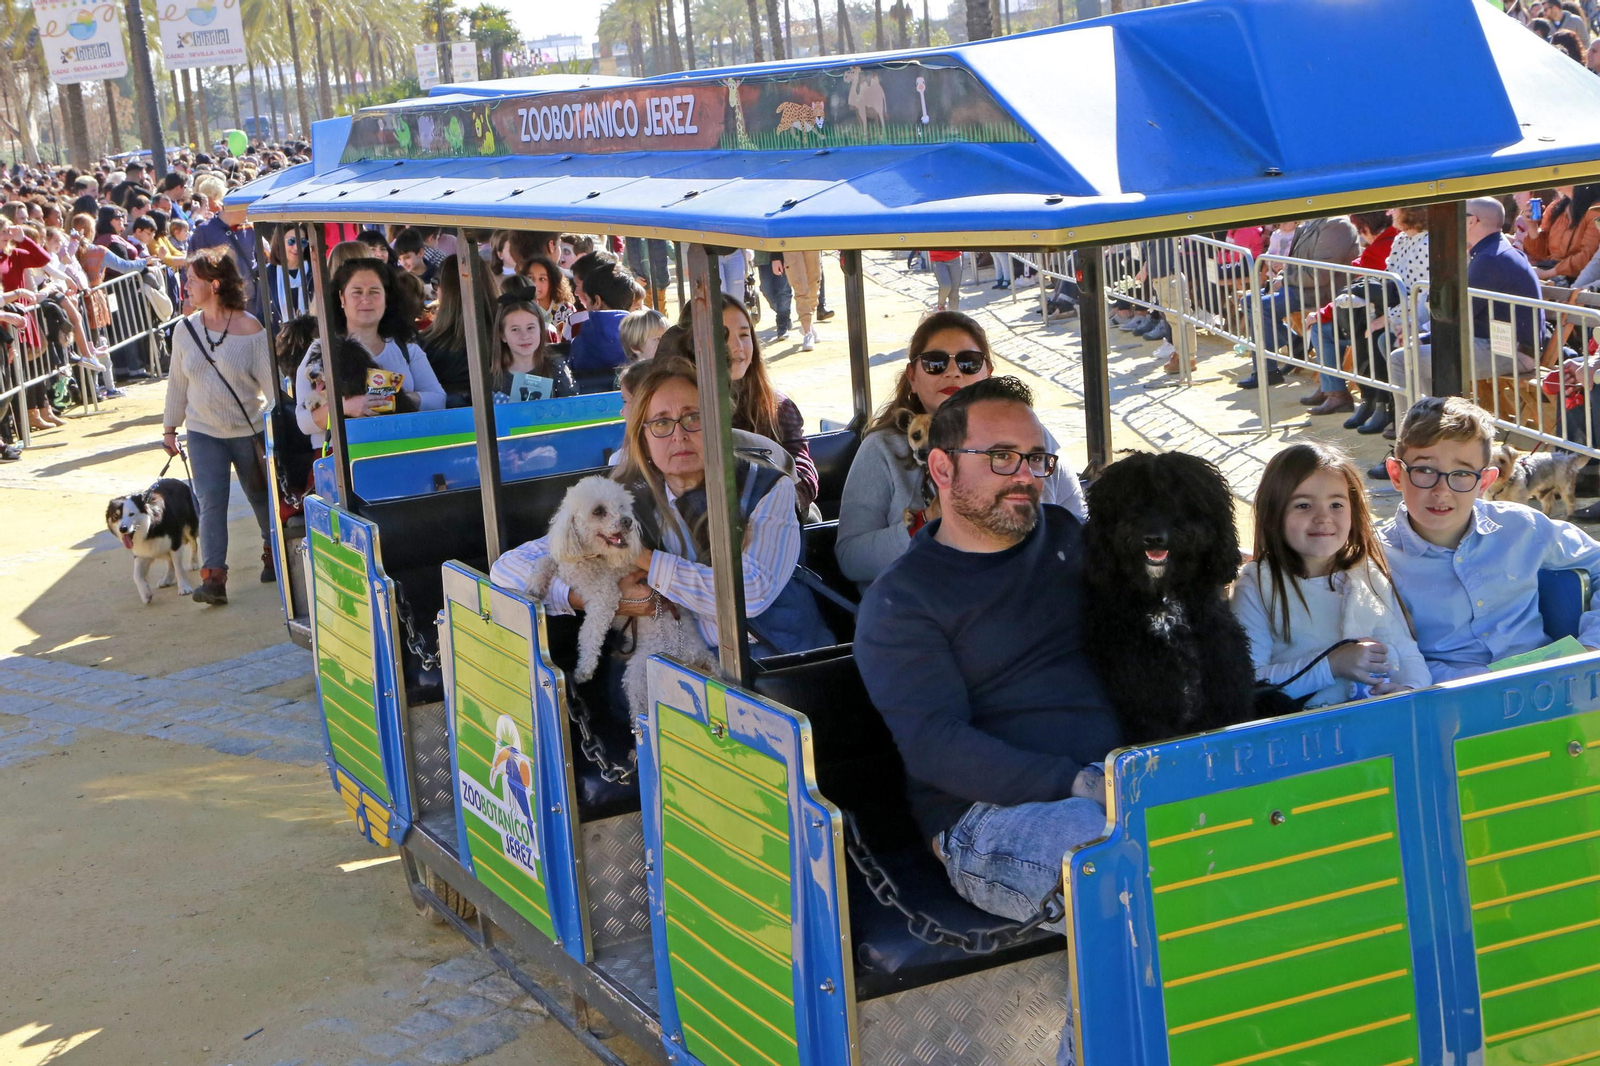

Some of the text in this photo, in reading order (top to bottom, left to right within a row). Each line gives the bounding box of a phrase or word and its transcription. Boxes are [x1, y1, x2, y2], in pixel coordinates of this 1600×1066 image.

[76, 43, 110, 61] Guadiel
[193, 29, 229, 47] Guadiel
[643, 94, 698, 137] JEREZ
[532, 399, 610, 420] DOTTO
[1198, 724, 1345, 781] TRENI
[505, 833, 534, 871] JEREZ
